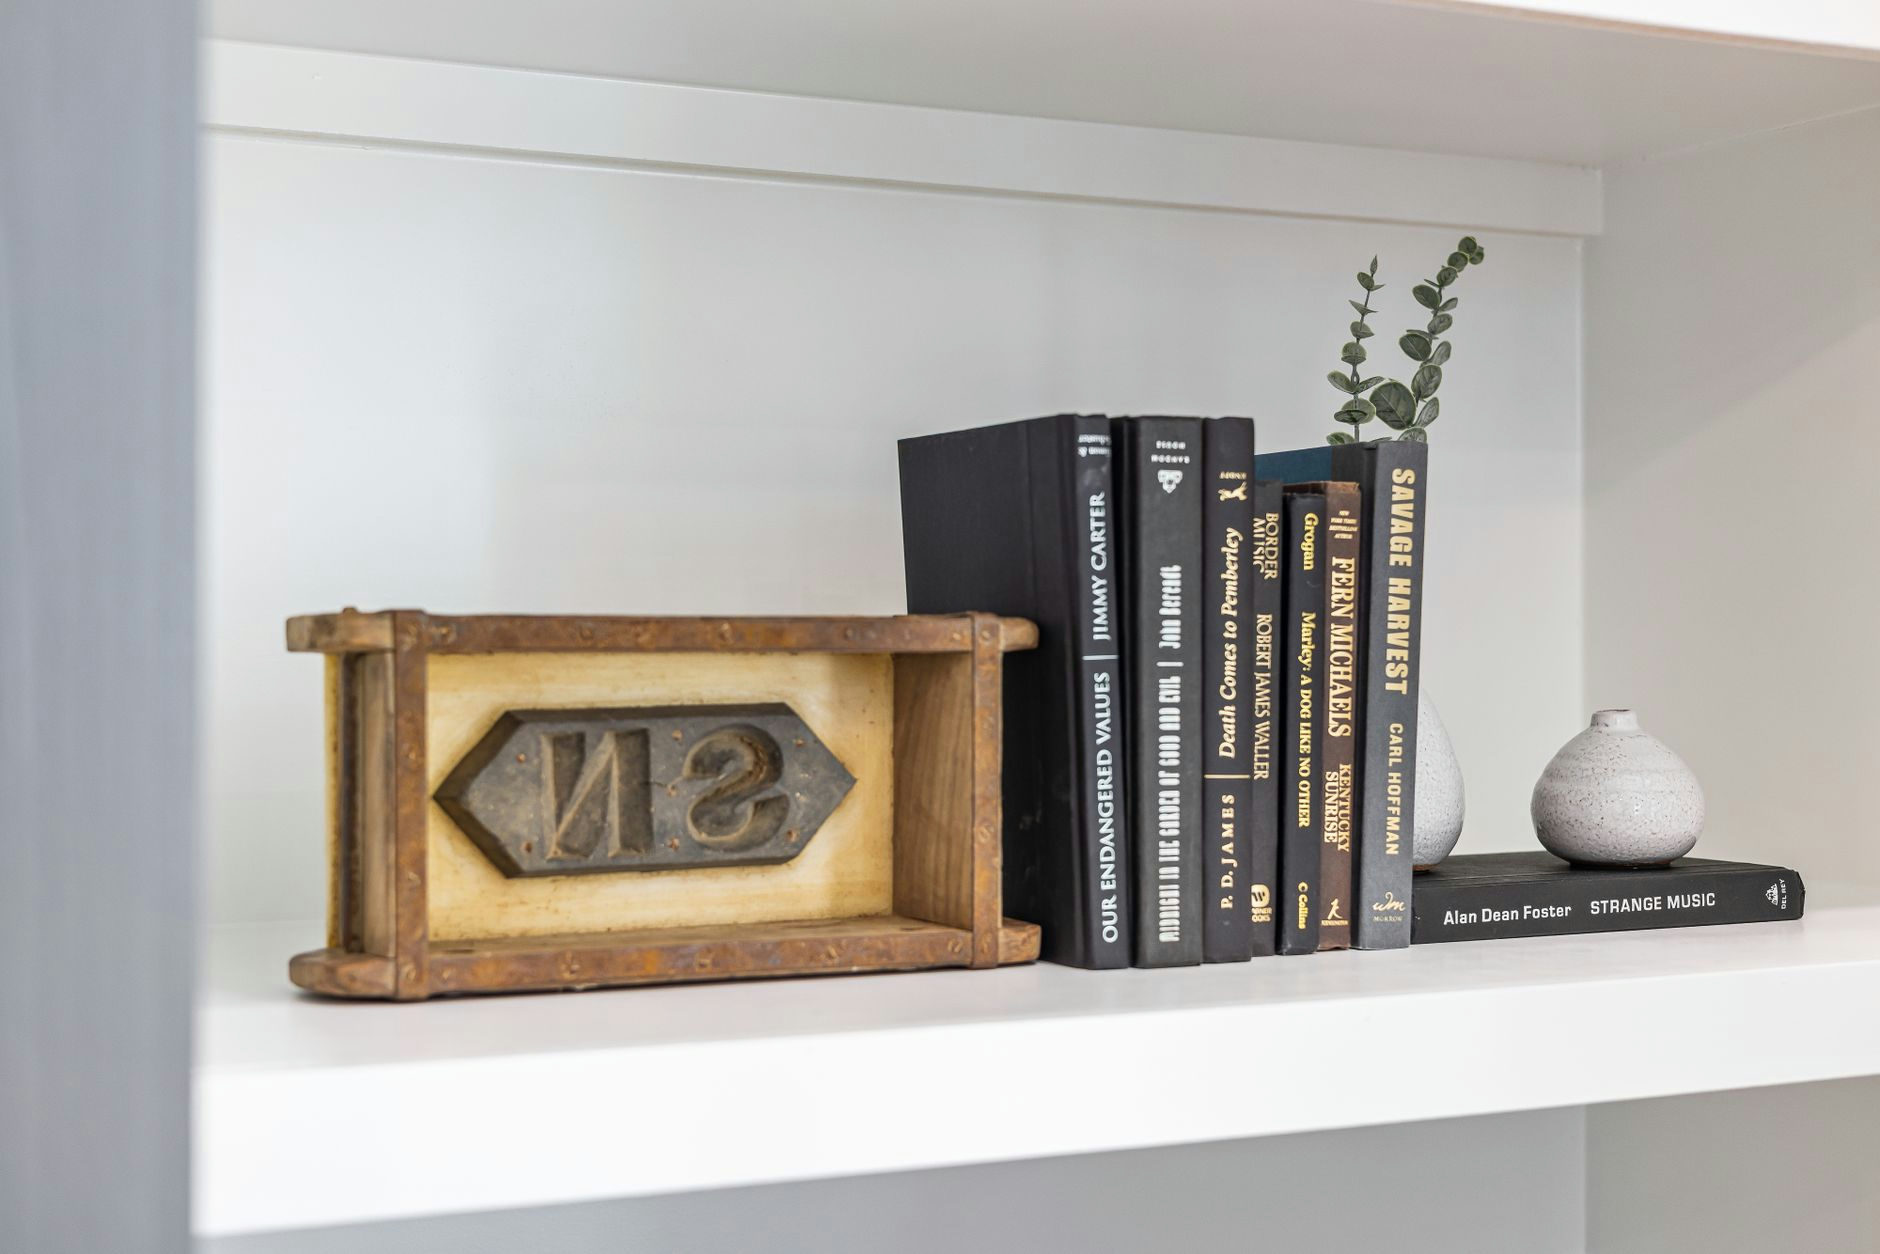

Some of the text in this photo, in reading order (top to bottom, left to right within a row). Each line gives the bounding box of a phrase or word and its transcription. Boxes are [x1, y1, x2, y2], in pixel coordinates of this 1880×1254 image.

[1089, 491, 1111, 641] JIMMY CARTER
[1264, 513, 1278, 579] BORDER
[1300, 512, 1319, 571] Grogan
[1330, 556, 1355, 619] FERN
[1385, 468, 1416, 695] SAVAGE HARVEST
[1158, 619, 1182, 650] John
[1218, 527, 1244, 759] Death Comes to Pemberley
[1327, 622, 1354, 738] MICHAELS
[1253, 614, 1273, 780] ROBERT JAMES WALLER
[1297, 611, 1316, 828] Marley: A DOG LIKE NO OTHER
[1093, 672, 1119, 944] OUR ENDANGERED VALUES
[1157, 675, 1181, 943] MIDNIGHT IN THE GARDEN OF GOOD AND EVIL
[1325, 764, 1352, 852] KENTUCKY SUNRISE
[1385, 723, 1404, 855] CARL HOFFMAN
[1220, 794, 1238, 909] P. D. JAMES
[1590, 892, 1716, 915] STRANGE MUSIC
[1778, 878, 1786, 894] REY
[1298, 893, 1309, 930] Collins
[1443, 905, 1572, 926] Alan Dean Foster
